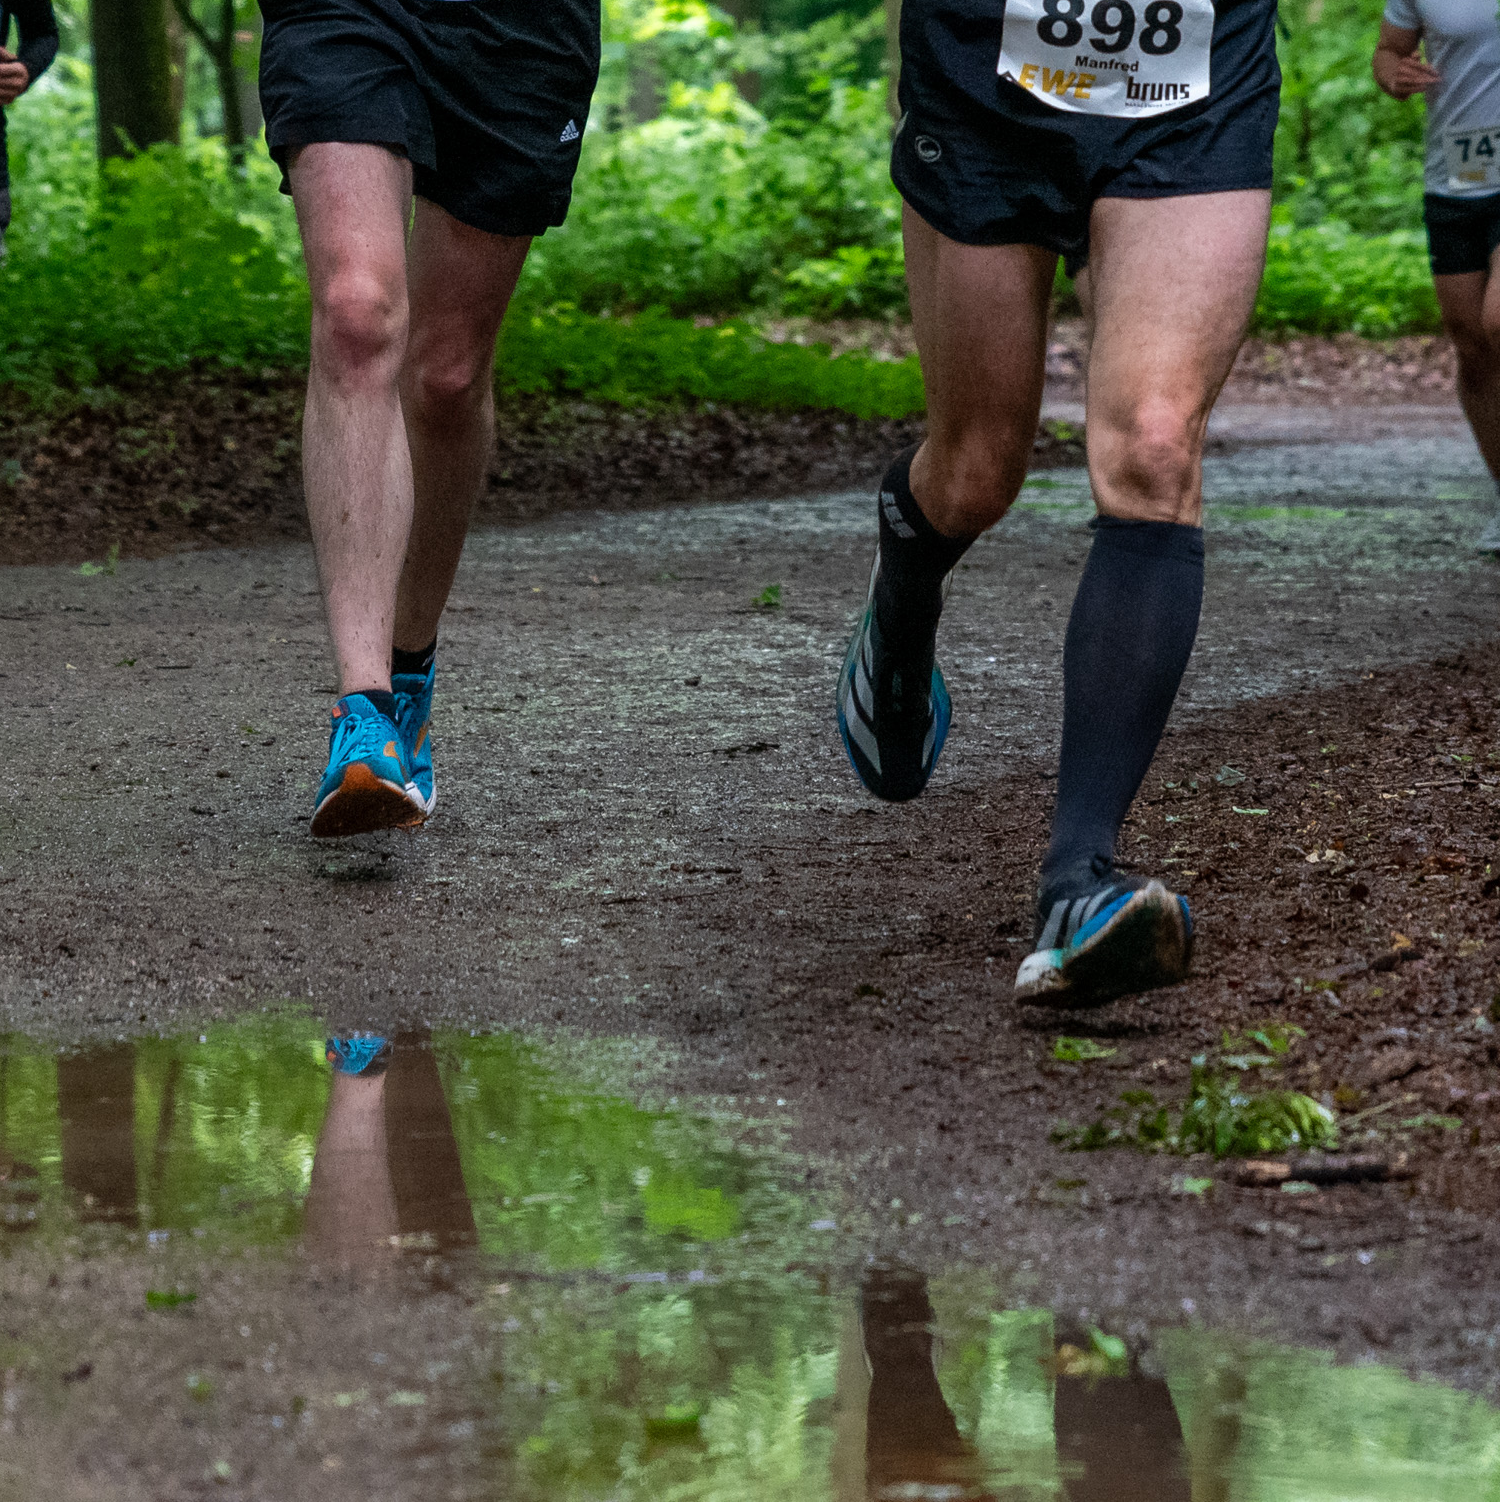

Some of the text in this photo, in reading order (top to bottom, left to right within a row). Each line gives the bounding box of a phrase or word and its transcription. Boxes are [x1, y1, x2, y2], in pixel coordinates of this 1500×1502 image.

[1075, 55, 1139, 73] Manfred
[1018, 63, 1097, 99] EWE
[1126, 76, 1190, 101] bruns
